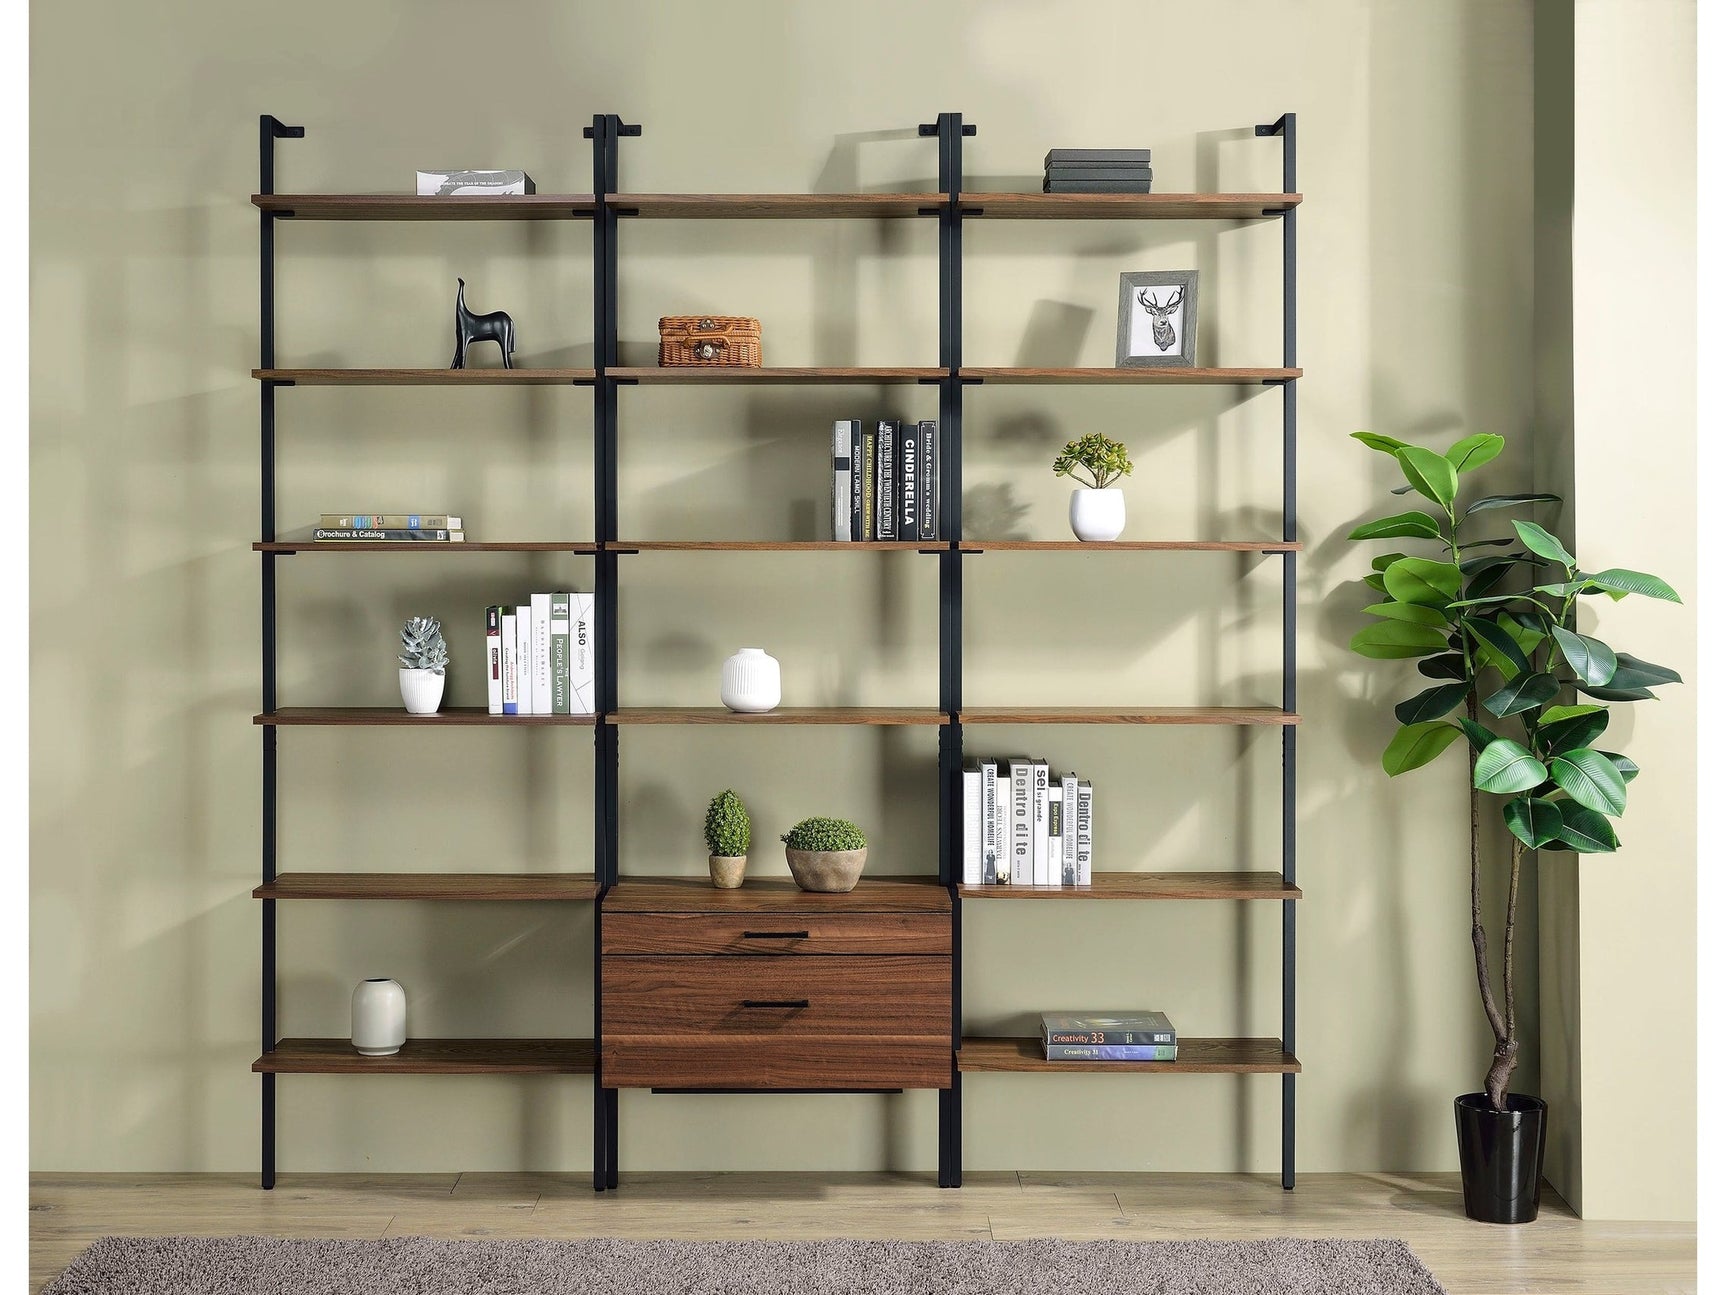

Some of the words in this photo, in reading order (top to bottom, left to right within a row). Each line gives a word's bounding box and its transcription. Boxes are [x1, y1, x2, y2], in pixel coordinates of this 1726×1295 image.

[884, 469, 892, 478] THE
[904, 439, 915, 525] CINDERELLA
[359, 530, 385, 539] Catalog
[578, 620, 586, 646] ALSO
[556, 638, 564, 674] PEOPLE'S
[987, 768, 995, 787] CREATE
[1016, 768, 1028, 817] Dentro
[1066, 782, 1074, 800] CREATE
[987, 787, 995, 820] WONDERFUL
[1078, 793, 1091, 830] Dentro
[1066, 802, 1074, 833] WONDERFUL
[987, 820, 995, 846] HOMELIFE
[1016, 824, 1028, 837] di
[1078, 835, 1090, 845] di
[1016, 842, 1028, 855] te
[1078, 851, 1090, 862] te
[1052, 1034, 1089, 1043] Creativity
[1091, 1032, 1105, 1044] 33
